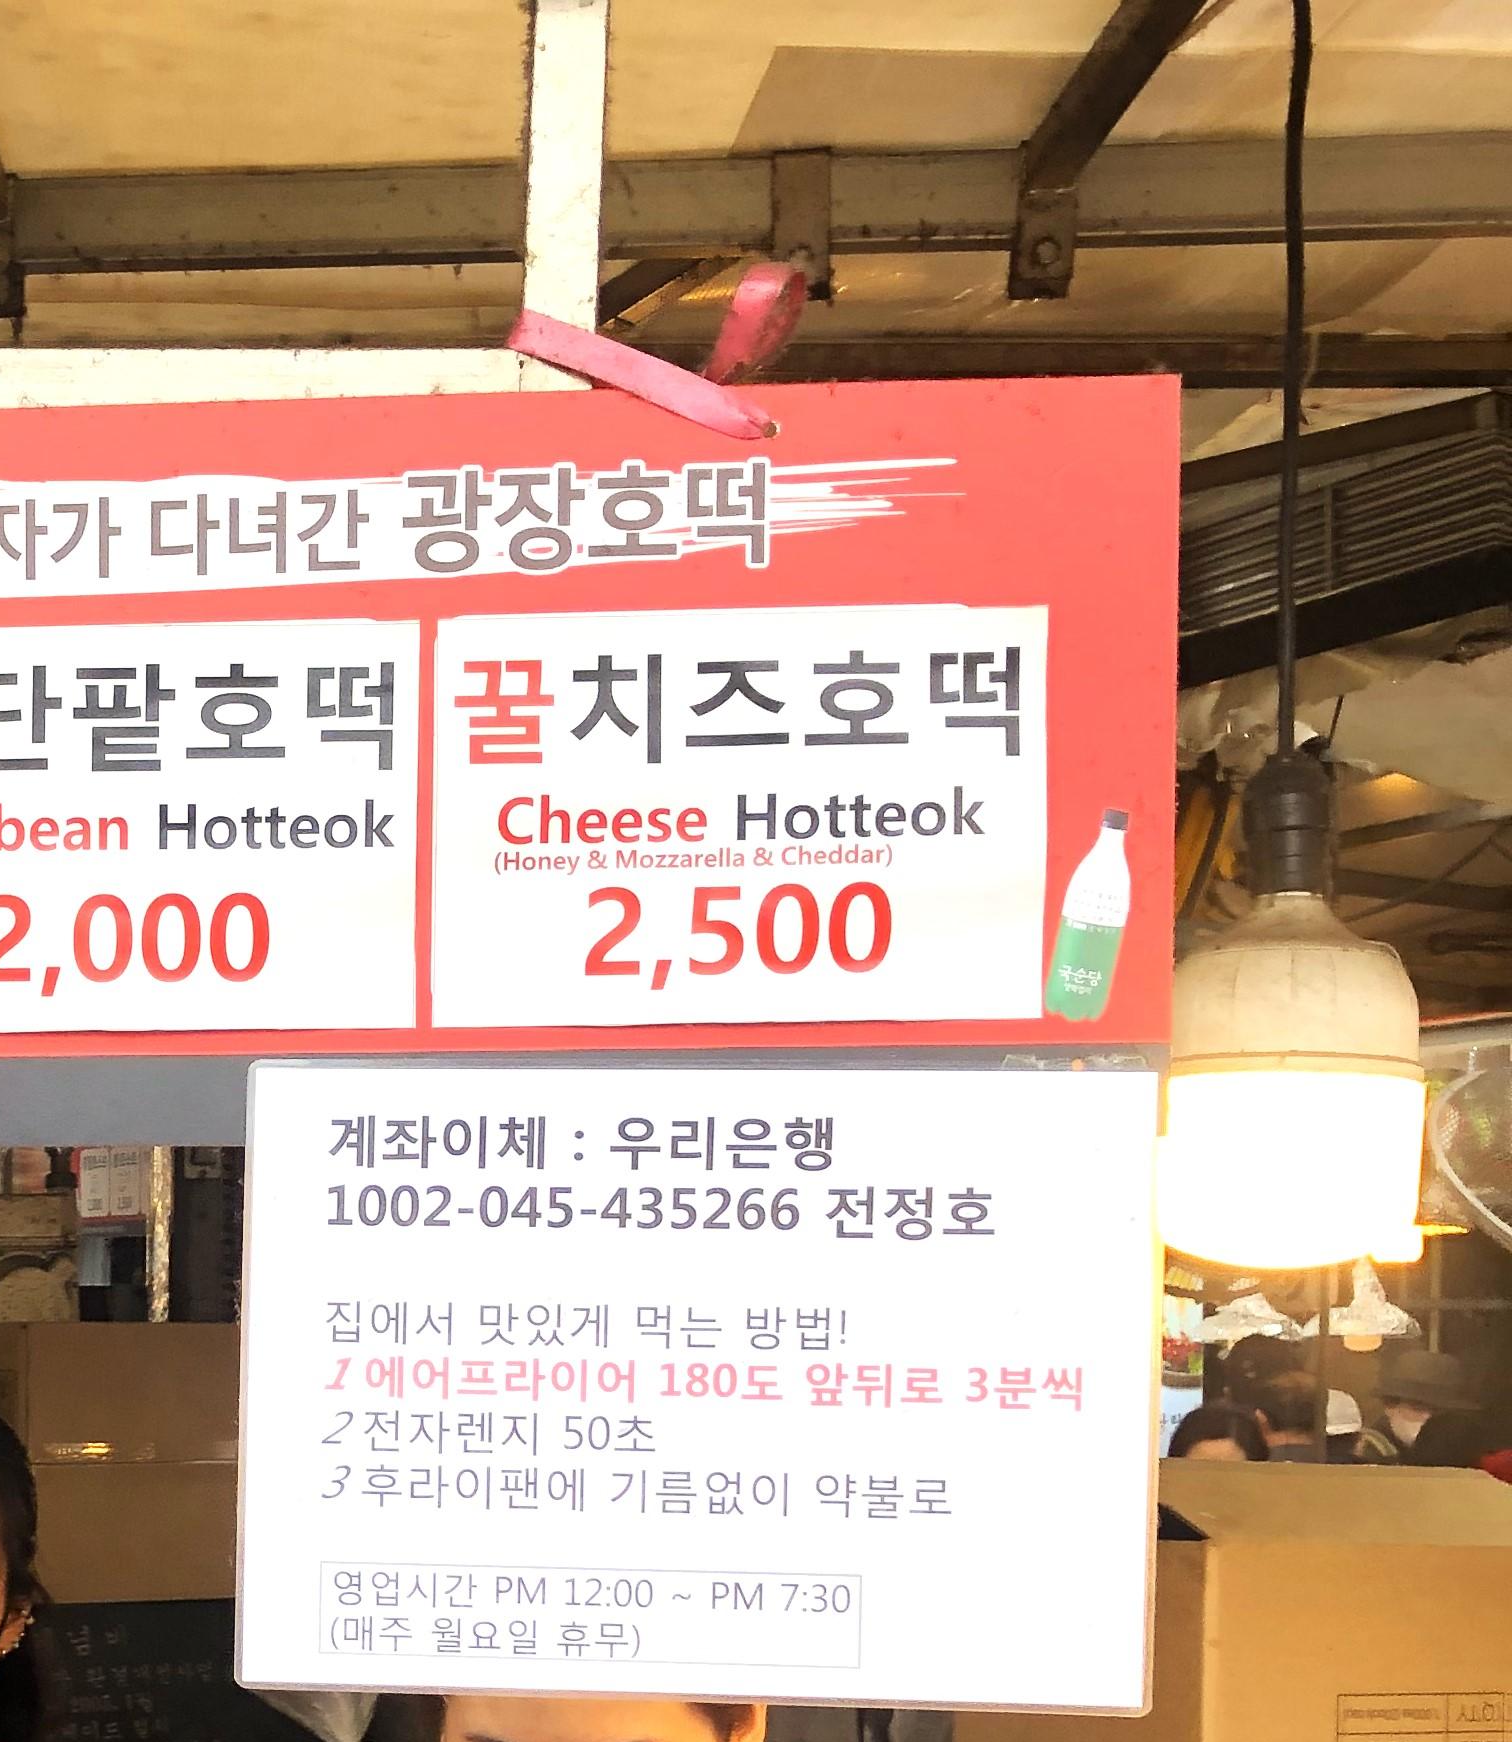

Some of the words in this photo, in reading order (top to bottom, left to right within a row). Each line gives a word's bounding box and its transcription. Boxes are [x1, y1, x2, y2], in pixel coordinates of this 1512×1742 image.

[149, 488, 368, 575] 다녀간
[401, 462, 767, 573] 광장호떡
[454, 646, 1020, 764] 꿀치즈호떡
[159, 799, 394, 849] Hotteok
[498, 795, 707, 845] Cheese
[737, 786, 984, 840] Hotteok
[495, 852, 580, 875] (Honey
[616, 847, 744, 868] Mozzarella
[781, 844, 892, 867] Cheddar)
[585, 882, 892, 990] 2,500
[329, 1116, 545, 1169] 계좌이체
[610, 1117, 833, 1171] 우리은행
[328, 1185, 799, 1230] 1002-045-435266
[826, 1186, 995, 1240] 전정호
[326, 1301, 452, 1345] 집에서
[480, 1303, 608, 1348] 맛있게
[637, 1305, 722, 1349] 먹는
[747, 1307, 845, 1350] 방법!
[661, 1363, 782, 1400] 180도
[806, 1363, 942, 1408] 앞뒤로
[967, 1368, 1082, 1411] 3분씩
[564, 1416, 655, 1452] 50초
[611, 1470, 788, 1517] 기름없이
[816, 1474, 951, 1518] 약불로
[334, 1571, 478, 1608] 영업시간
[496, 1576, 545, 1604] PM
[566, 1578, 653, 1607] 12:00
[712, 1582, 762, 1610] PM
[781, 1584, 850, 1613] 7:30
[331, 1616, 412, 1651] (매주
[432, 1618, 536, 1654] 월요일
[557, 1622, 640, 1658] 휴무)
